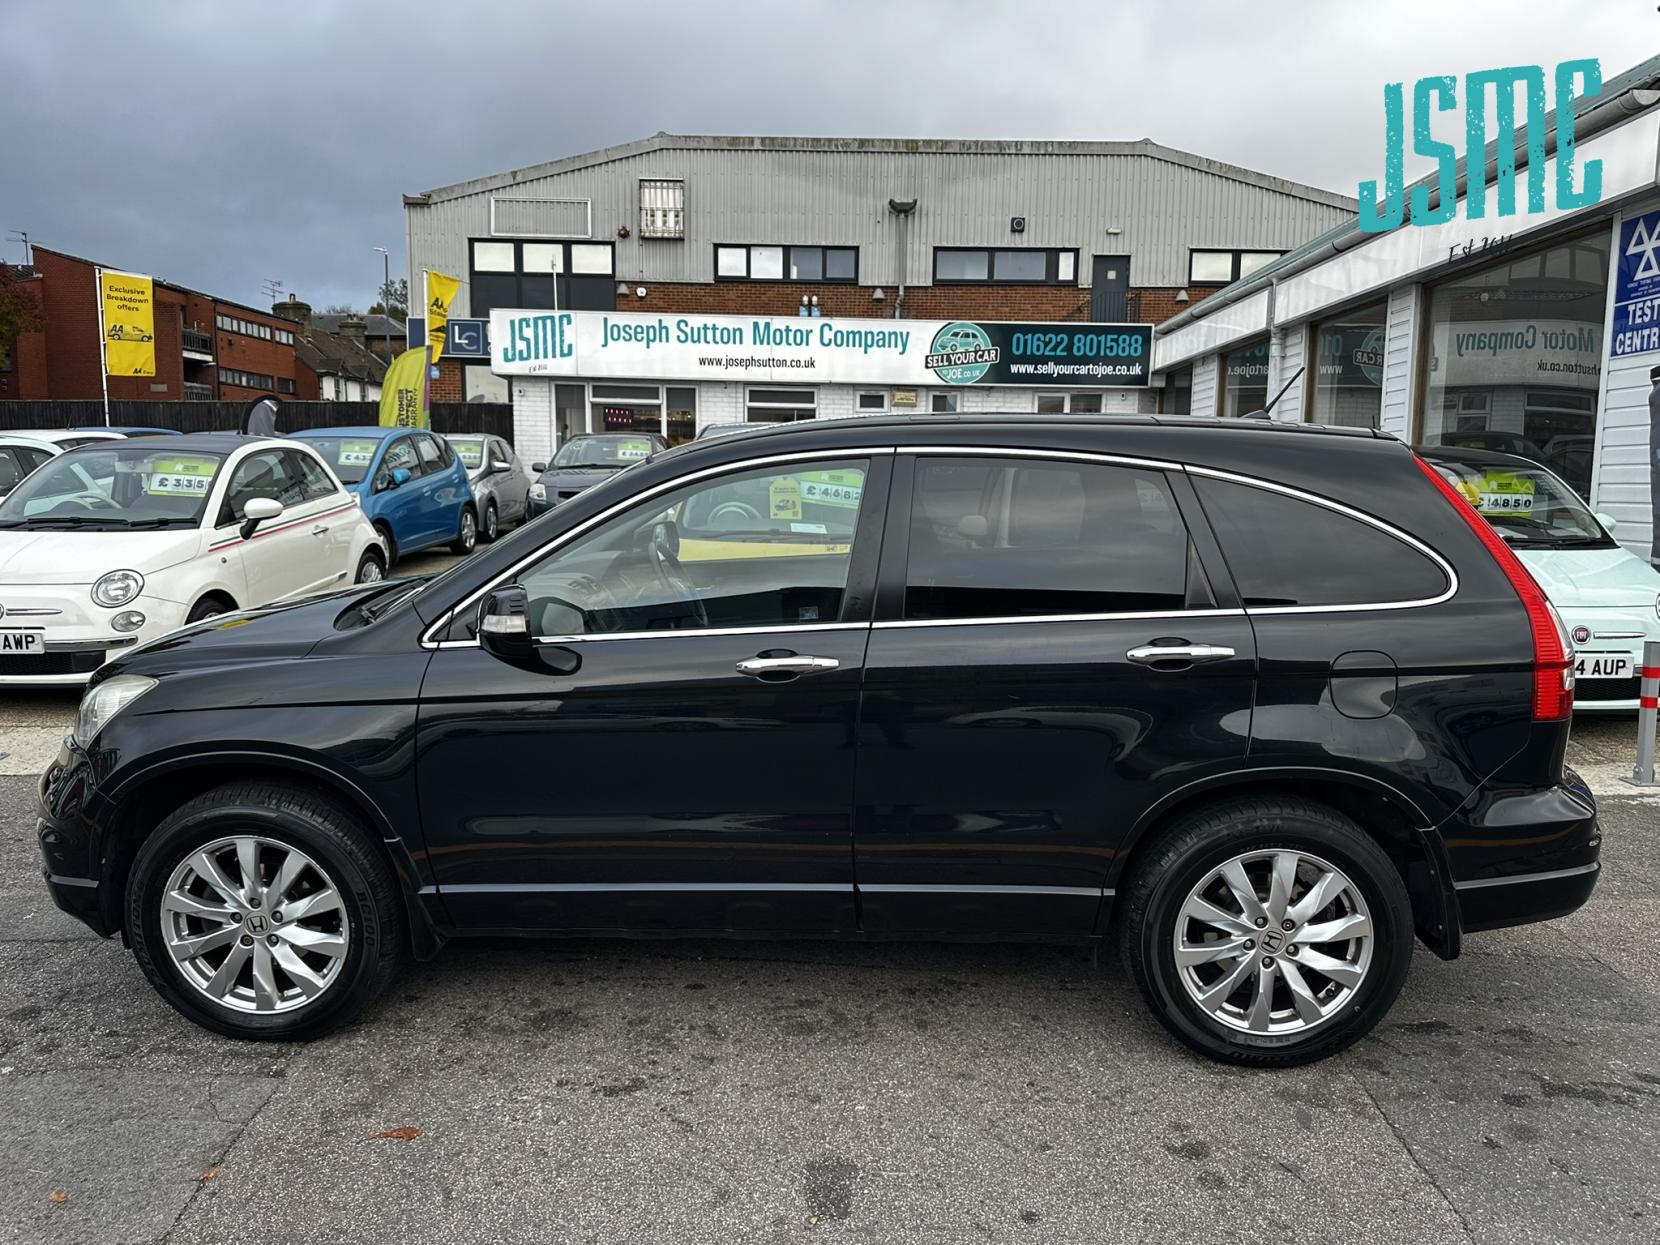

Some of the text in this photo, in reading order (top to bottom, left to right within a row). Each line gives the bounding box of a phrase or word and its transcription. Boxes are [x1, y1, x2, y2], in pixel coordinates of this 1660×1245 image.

[106, 293, 149, 304] Breakdown
[109, 285, 145, 296] Exclusive
[117, 303, 140, 312] offers
[1627, 298, 1660, 326] TEST
[110, 324, 124, 334] AA
[601, 316, 911, 356] Joseph Sutton Motor Company
[503, 314, 573, 363] JSMC
[1011, 332, 1142, 357] 01622 801588
[698, 355, 816, 371] www.josephsutton.co.uk
[927, 349, 996, 368] SELL YOUR CAR
[1010, 361, 1142, 378] www.sellyourcartojoe.co.uk
[3, 634, 35, 650] AWP
[1592, 659, 1627, 676] AUP
